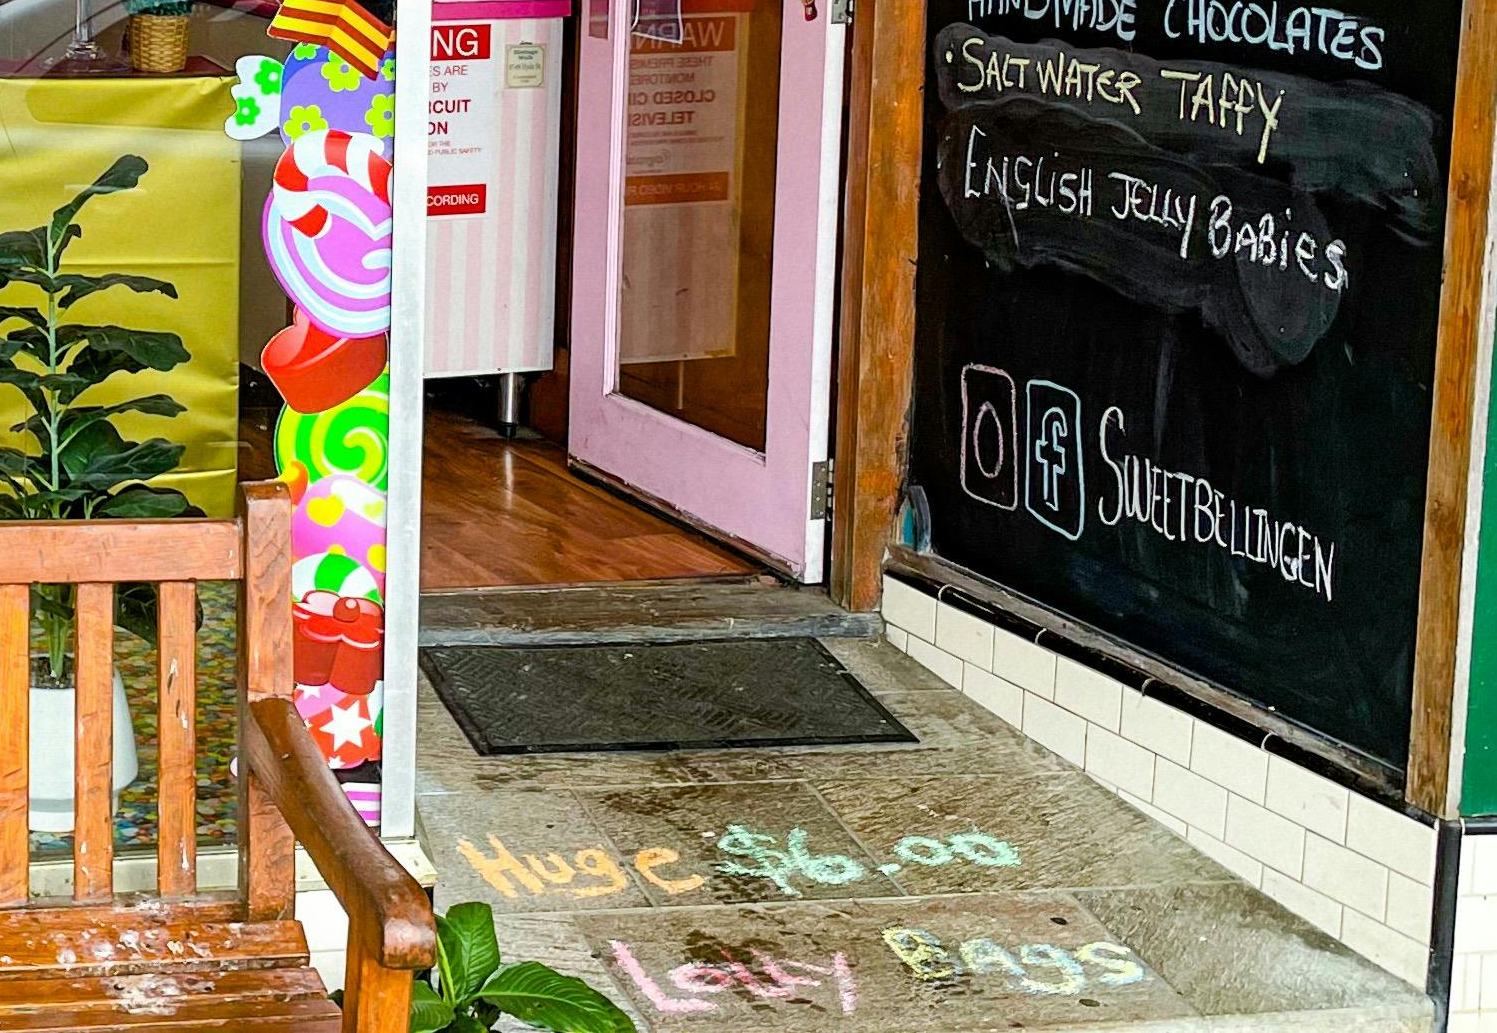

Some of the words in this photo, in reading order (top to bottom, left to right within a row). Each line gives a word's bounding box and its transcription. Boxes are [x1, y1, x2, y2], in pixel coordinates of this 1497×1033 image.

[432, 82, 449, 93] BY
[443, 65, 469, 76] ARE
[428, 98, 471, 114] CUIT
[1160, 70, 1287, 165] TAFFY
[427, 194, 479, 207] CORDING
[1108, 170, 1198, 258] JELLY
[1097, 406, 1336, 603] SWEETBELLINGEN
[455, 832, 705, 900] Huge
